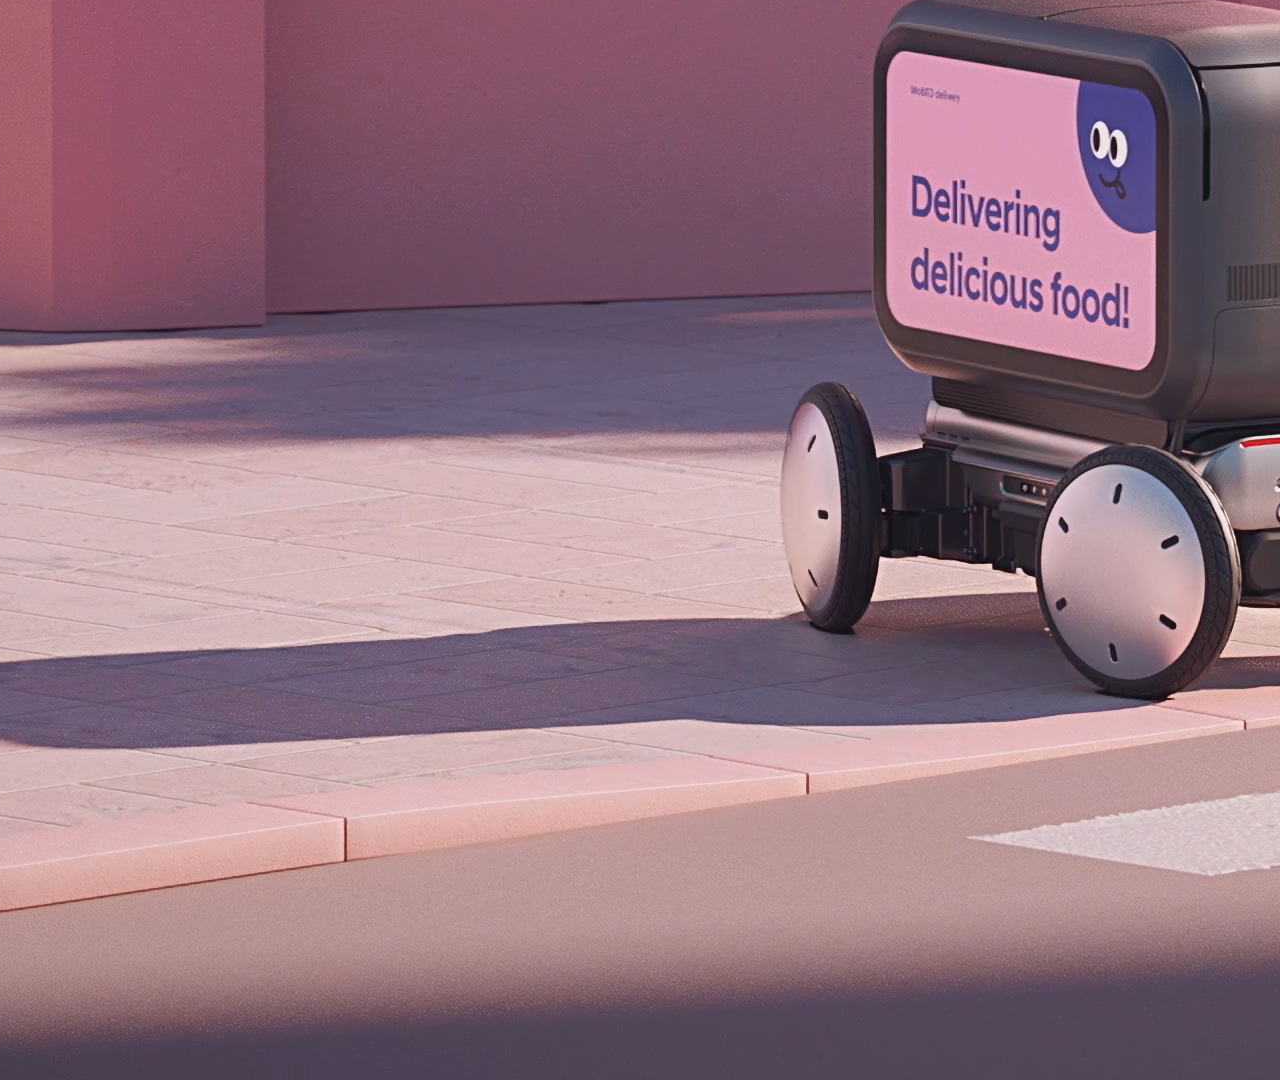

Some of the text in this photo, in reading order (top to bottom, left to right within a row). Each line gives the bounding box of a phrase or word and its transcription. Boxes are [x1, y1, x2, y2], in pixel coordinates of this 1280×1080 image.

[911, 174, 1061, 253] Delivering
[910, 247, 1130, 329] delicious food!
